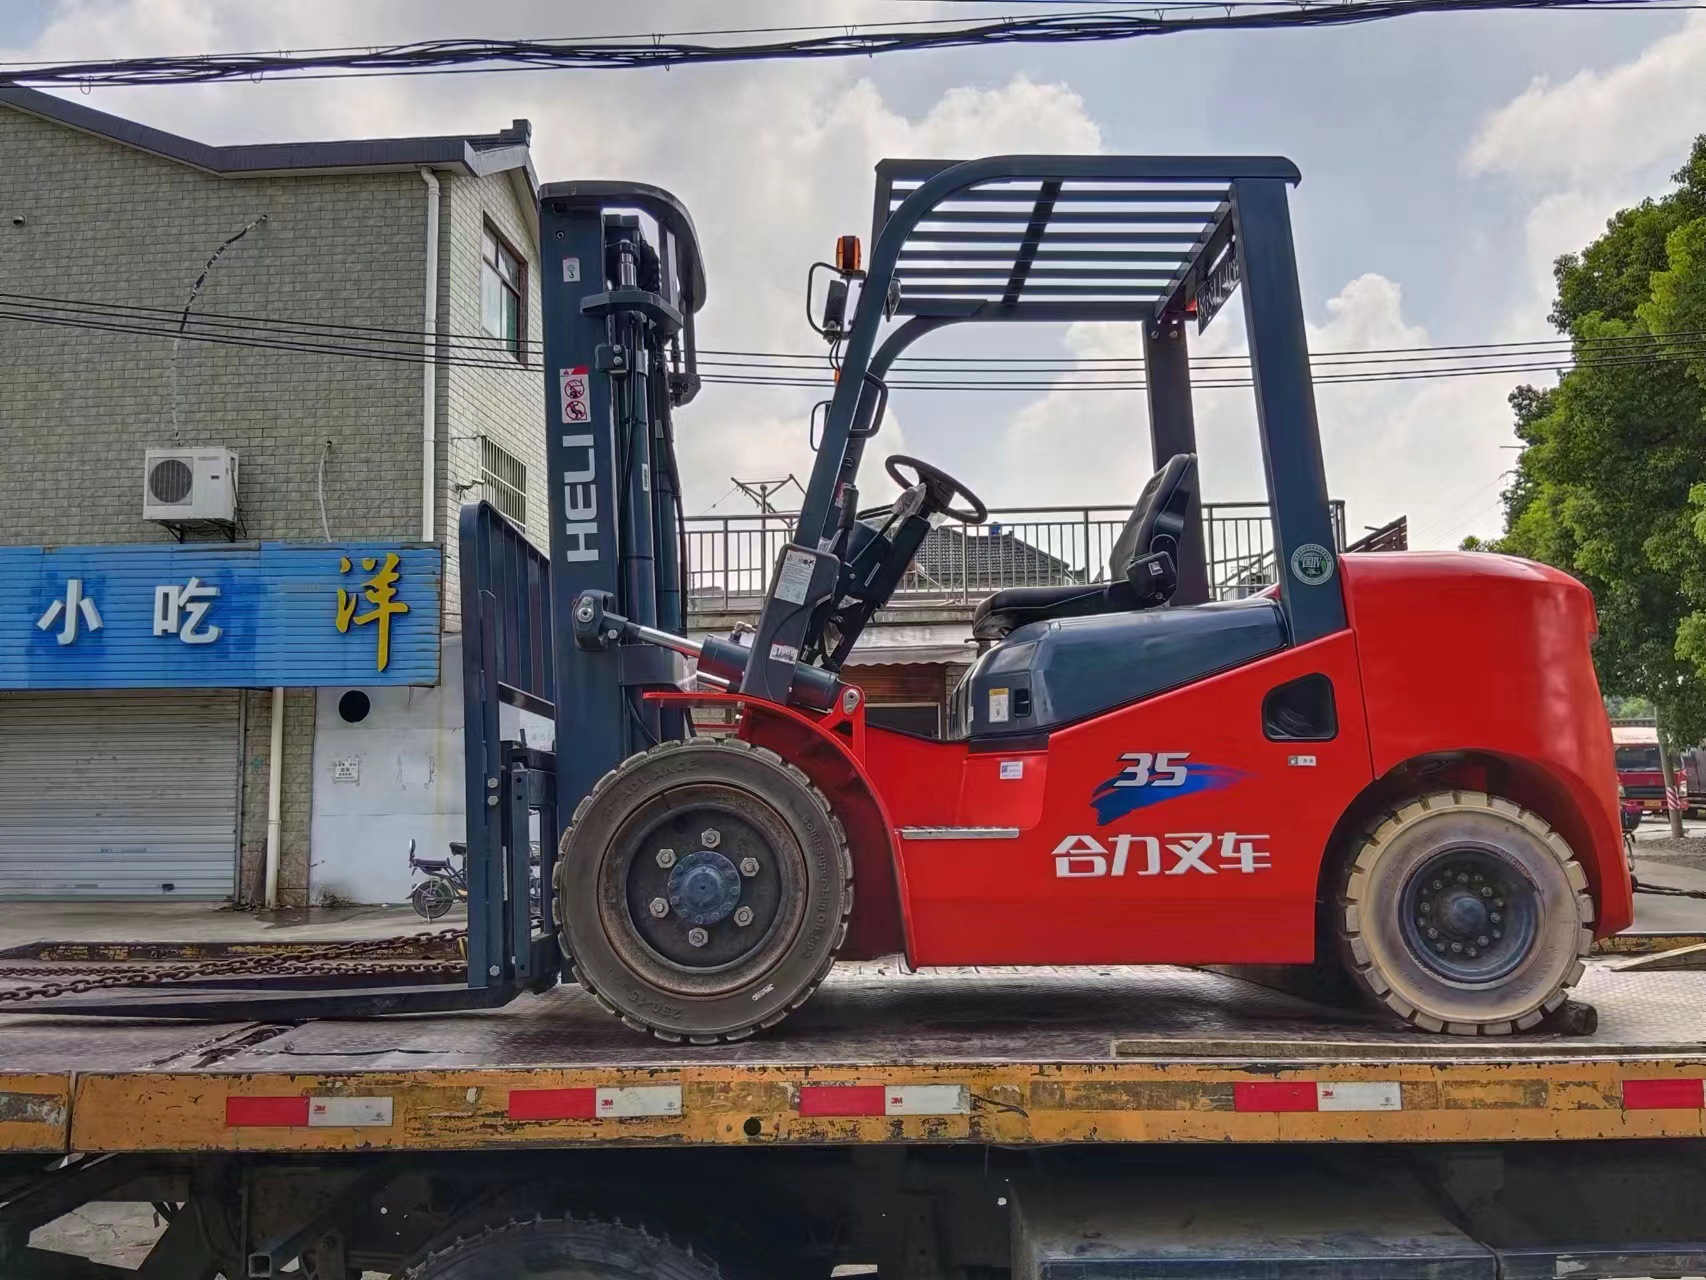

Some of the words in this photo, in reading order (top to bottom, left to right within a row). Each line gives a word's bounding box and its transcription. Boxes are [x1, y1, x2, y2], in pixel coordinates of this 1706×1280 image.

[562, 434, 599, 562] HELI
[36, 576, 223, 646] 小吃
[335, 552, 410, 673] 洋
[1113, 752, 1191, 787] 35
[1051, 832, 1272, 878] 合力叉车
[313, 1104, 326, 1112] 3M
